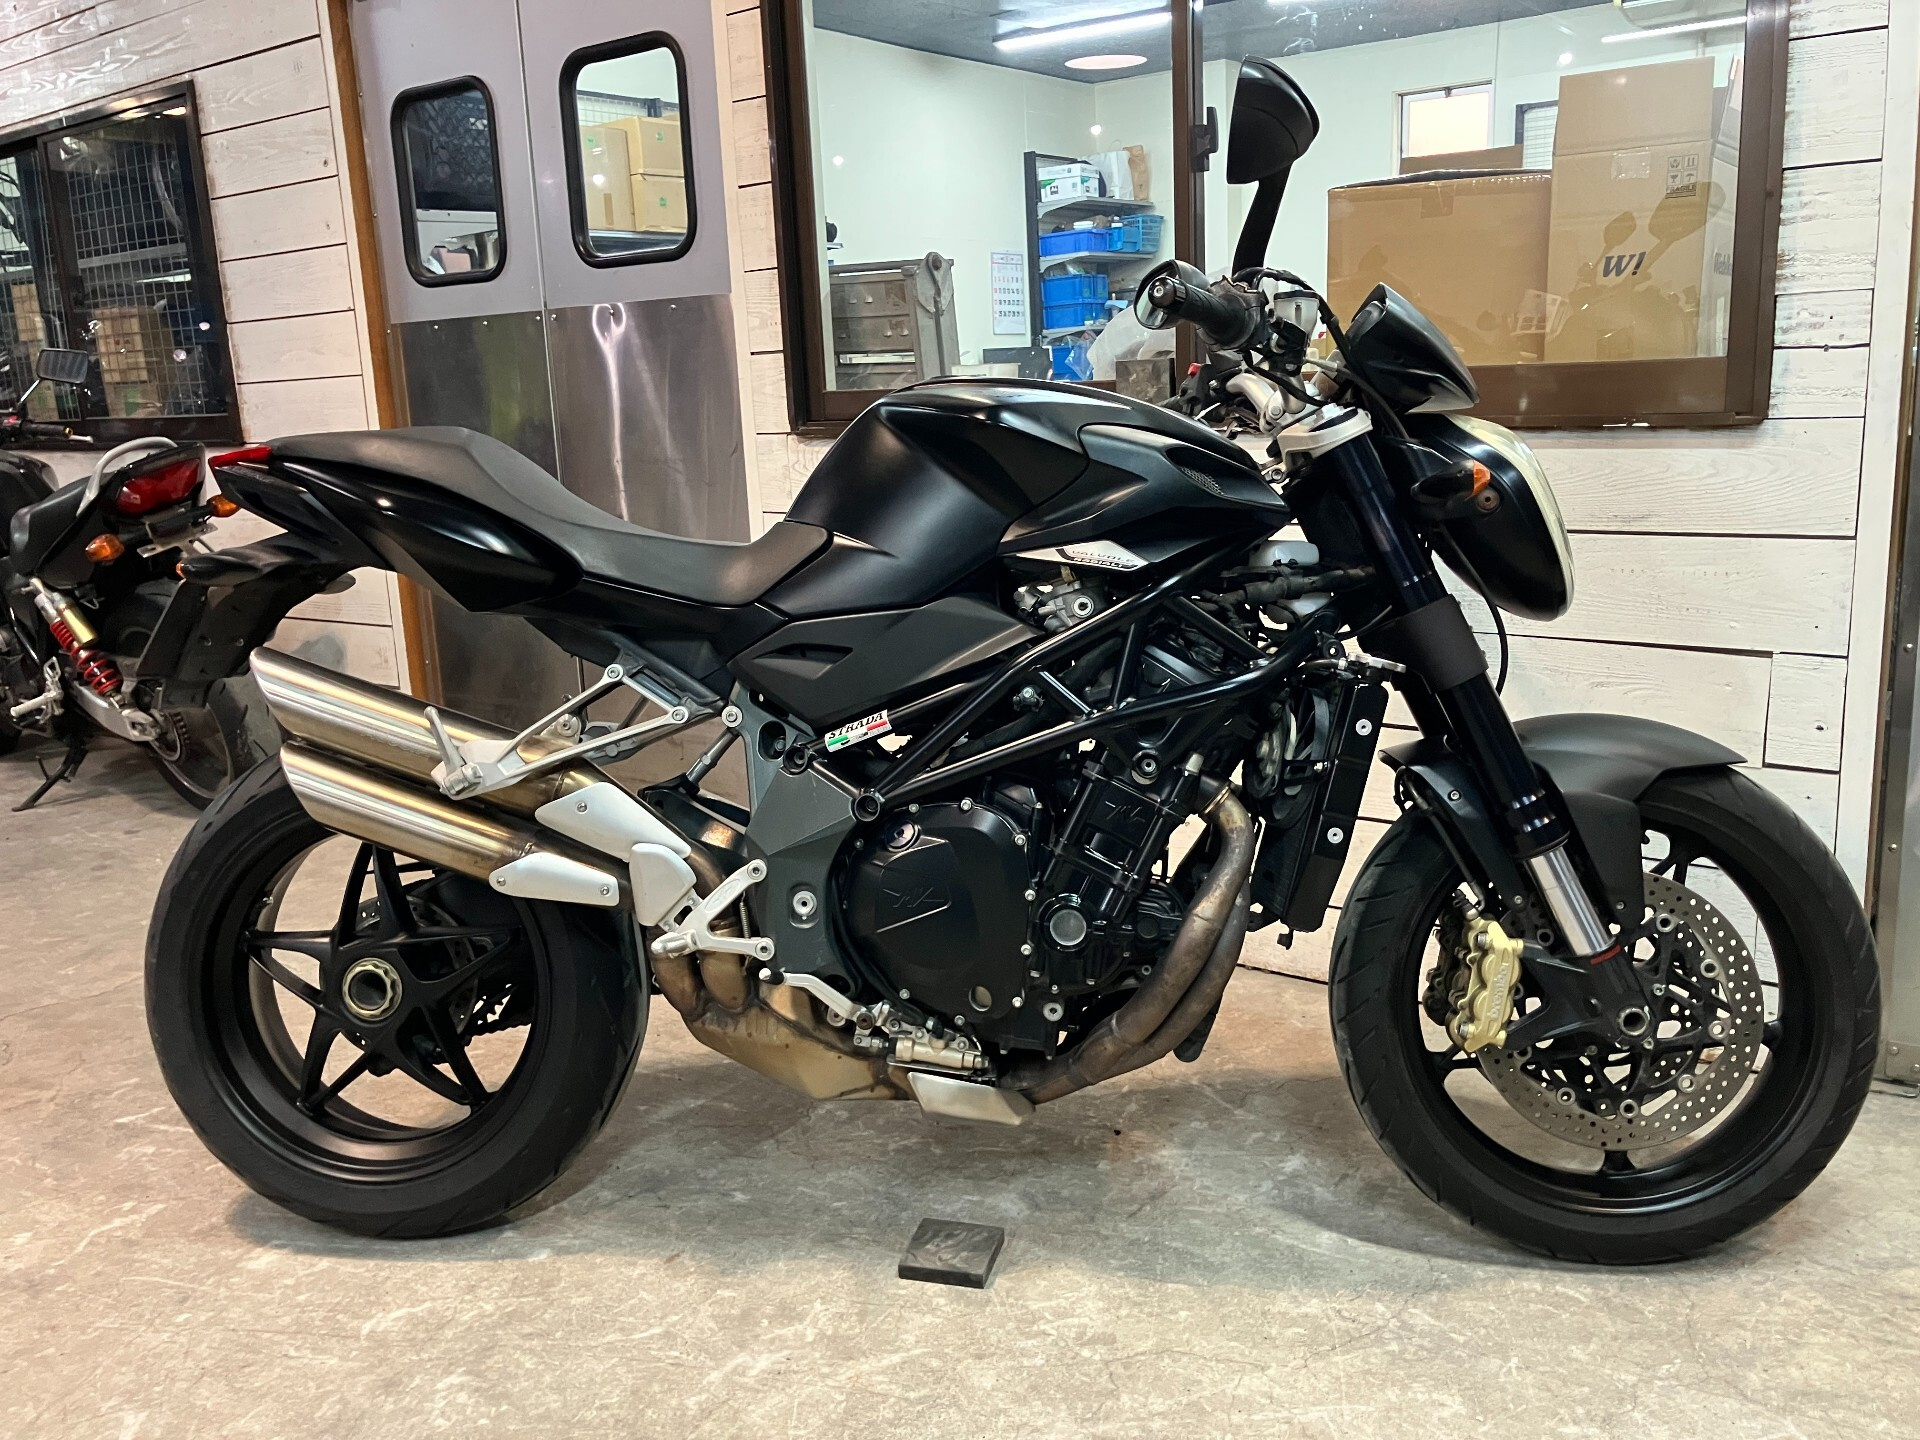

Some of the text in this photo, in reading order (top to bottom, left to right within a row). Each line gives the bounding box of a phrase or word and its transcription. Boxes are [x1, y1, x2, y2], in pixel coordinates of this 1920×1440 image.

[1602, 251, 1647, 278] W!
[828, 712, 884, 740] STRADA
[1487, 964, 1507, 1019] brembo
